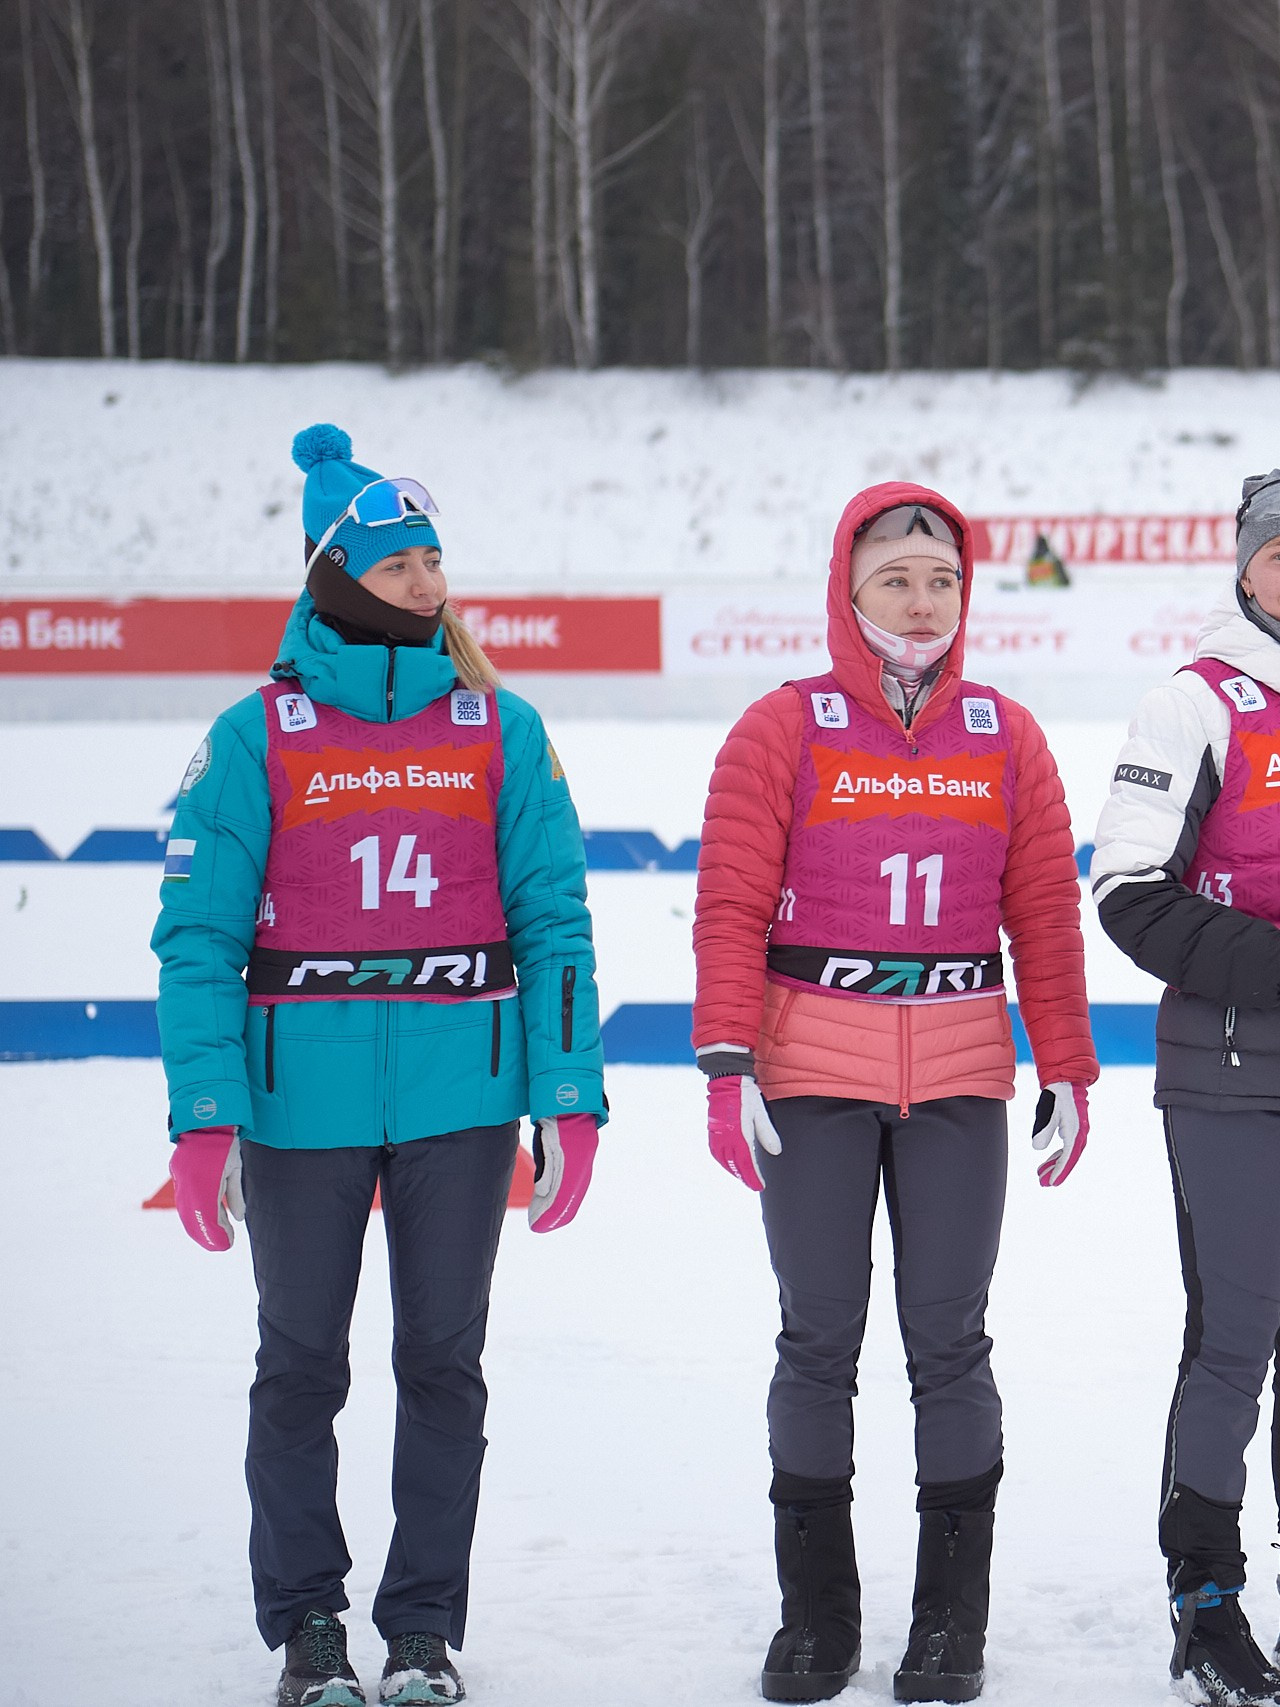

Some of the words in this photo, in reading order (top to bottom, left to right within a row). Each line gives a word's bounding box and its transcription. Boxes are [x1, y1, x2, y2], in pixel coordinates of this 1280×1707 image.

[26, 609, 123, 650] Банк
[457, 701, 480, 711] 2024
[457, 711, 481, 721] 2025
[969, 708, 991, 718] 2024
[970, 718, 993, 729] 2025
[305, 766, 401, 796] Альфа
[406, 765, 475, 790] Банк
[833, 771, 923, 800] Альфа
[928, 774, 992, 799] Банк
[1117, 766, 1162, 787] MOAX
[350, 834, 439, 910] 14
[880, 853, 943, 927] 11
[1196, 871, 1233, 907] 43
